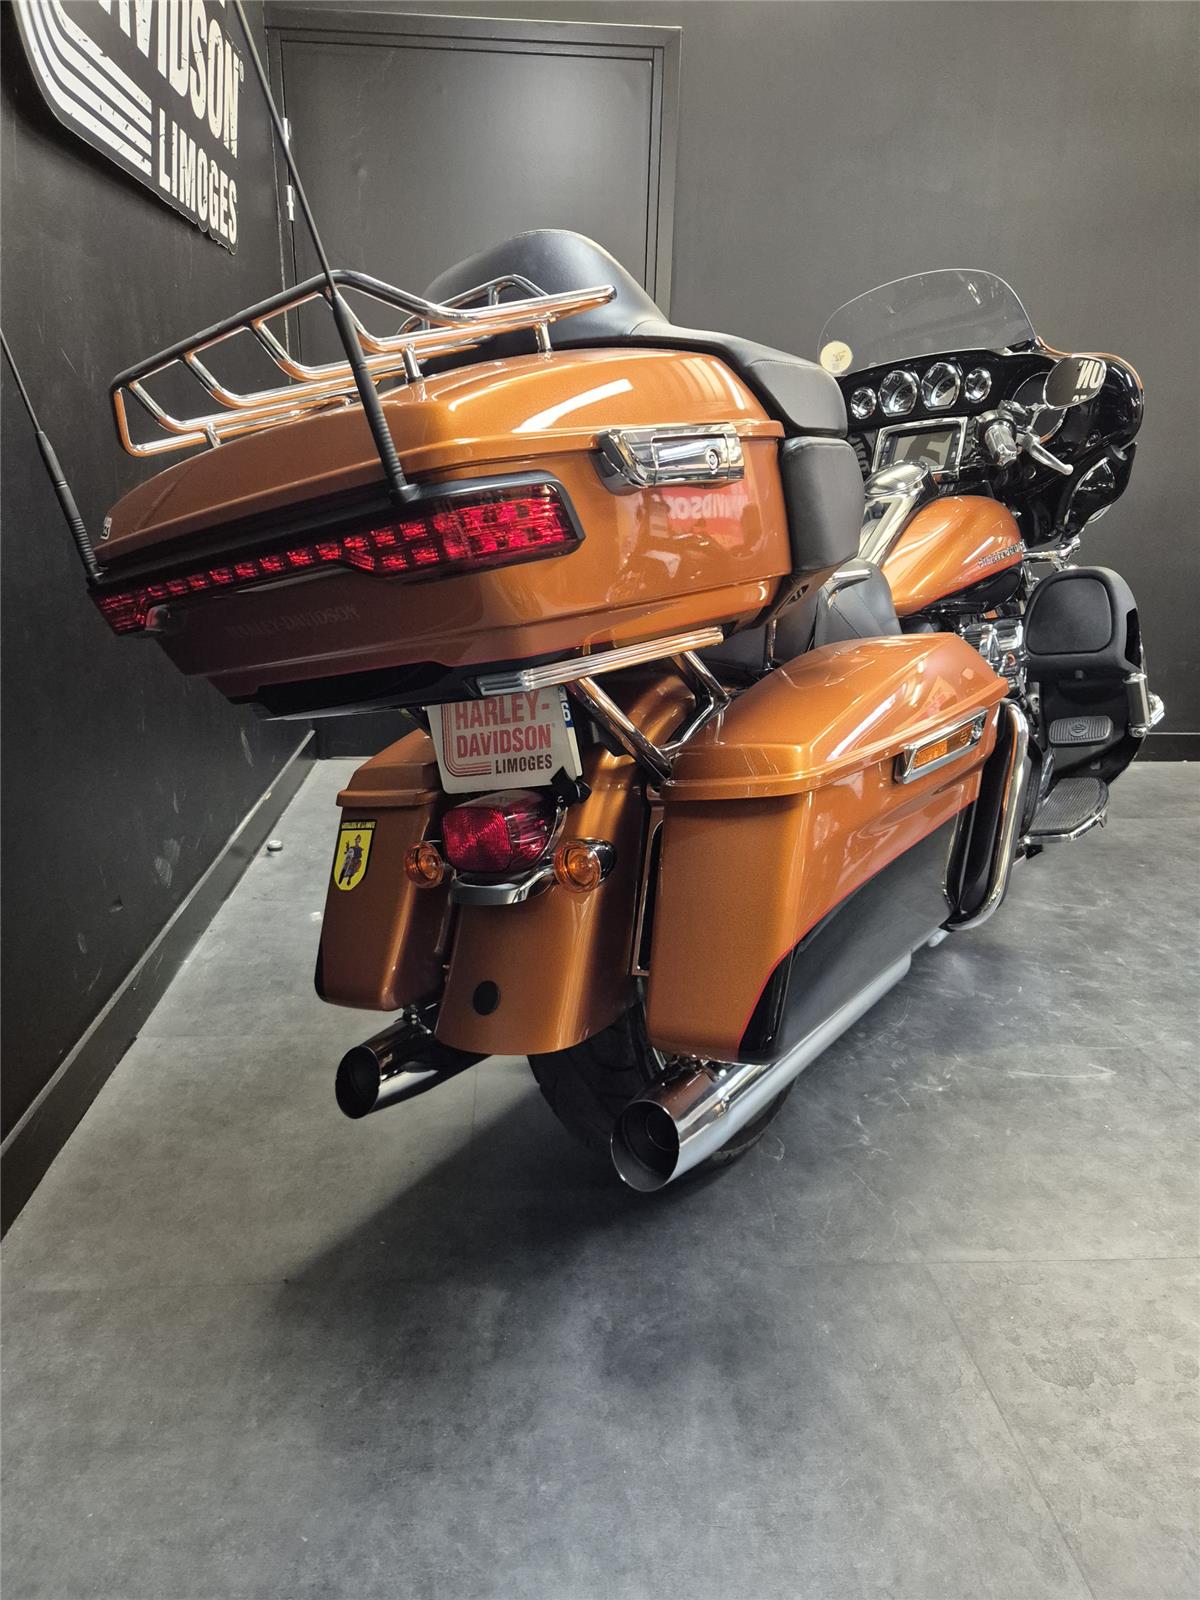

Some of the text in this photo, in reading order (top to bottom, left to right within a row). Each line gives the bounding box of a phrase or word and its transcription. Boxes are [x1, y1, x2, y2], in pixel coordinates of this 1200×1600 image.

[158, 107, 238, 245] LIMOGES
[455, 689, 550, 730] HARLEY-
[456, 723, 552, 759] DAVIDSON
[495, 754, 553, 774] LIMOGES
